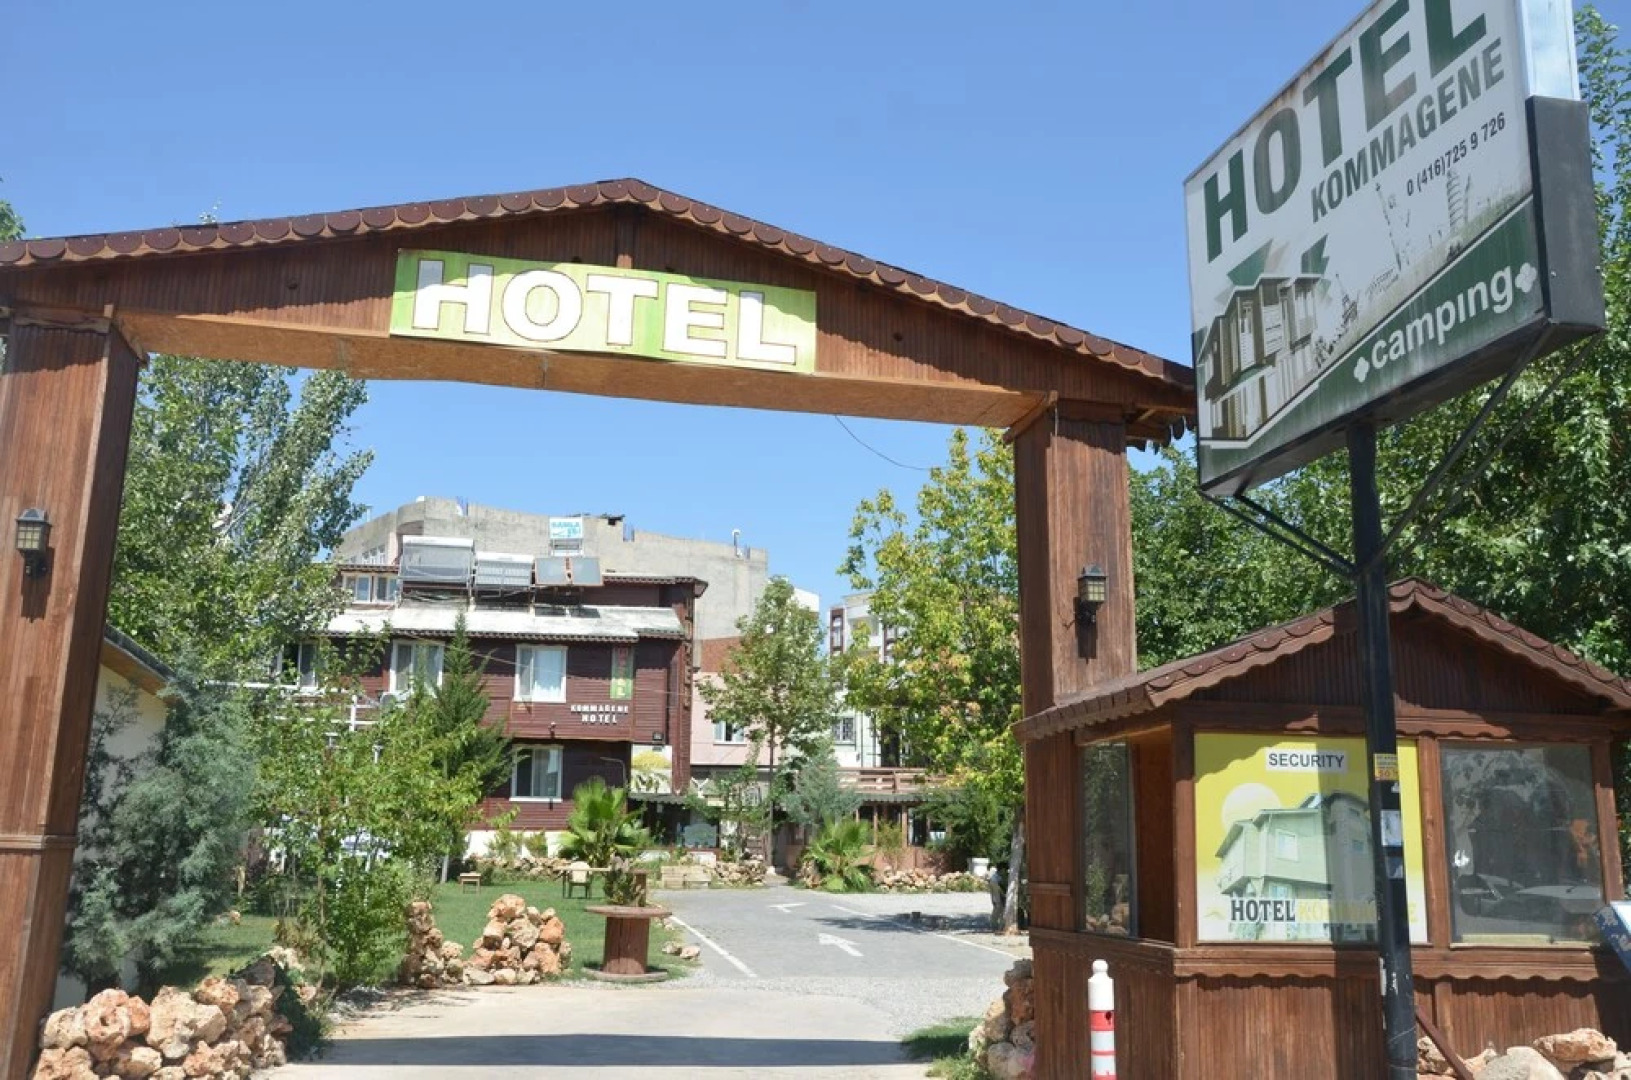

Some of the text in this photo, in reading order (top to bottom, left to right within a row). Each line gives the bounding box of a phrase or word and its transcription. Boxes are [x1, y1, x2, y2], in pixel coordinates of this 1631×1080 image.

[1204, 0, 1488, 263] HOTEL
[1311, 37, 1505, 223] KOMMAGENE
[1481, 111, 1505, 143] 726
[412, 259, 797, 366] HOTEL
[581, 714, 618, 724] HOTEL
[1268, 753, 1345, 768] SECURITY
[1231, 900, 1296, 922] HOTEL
